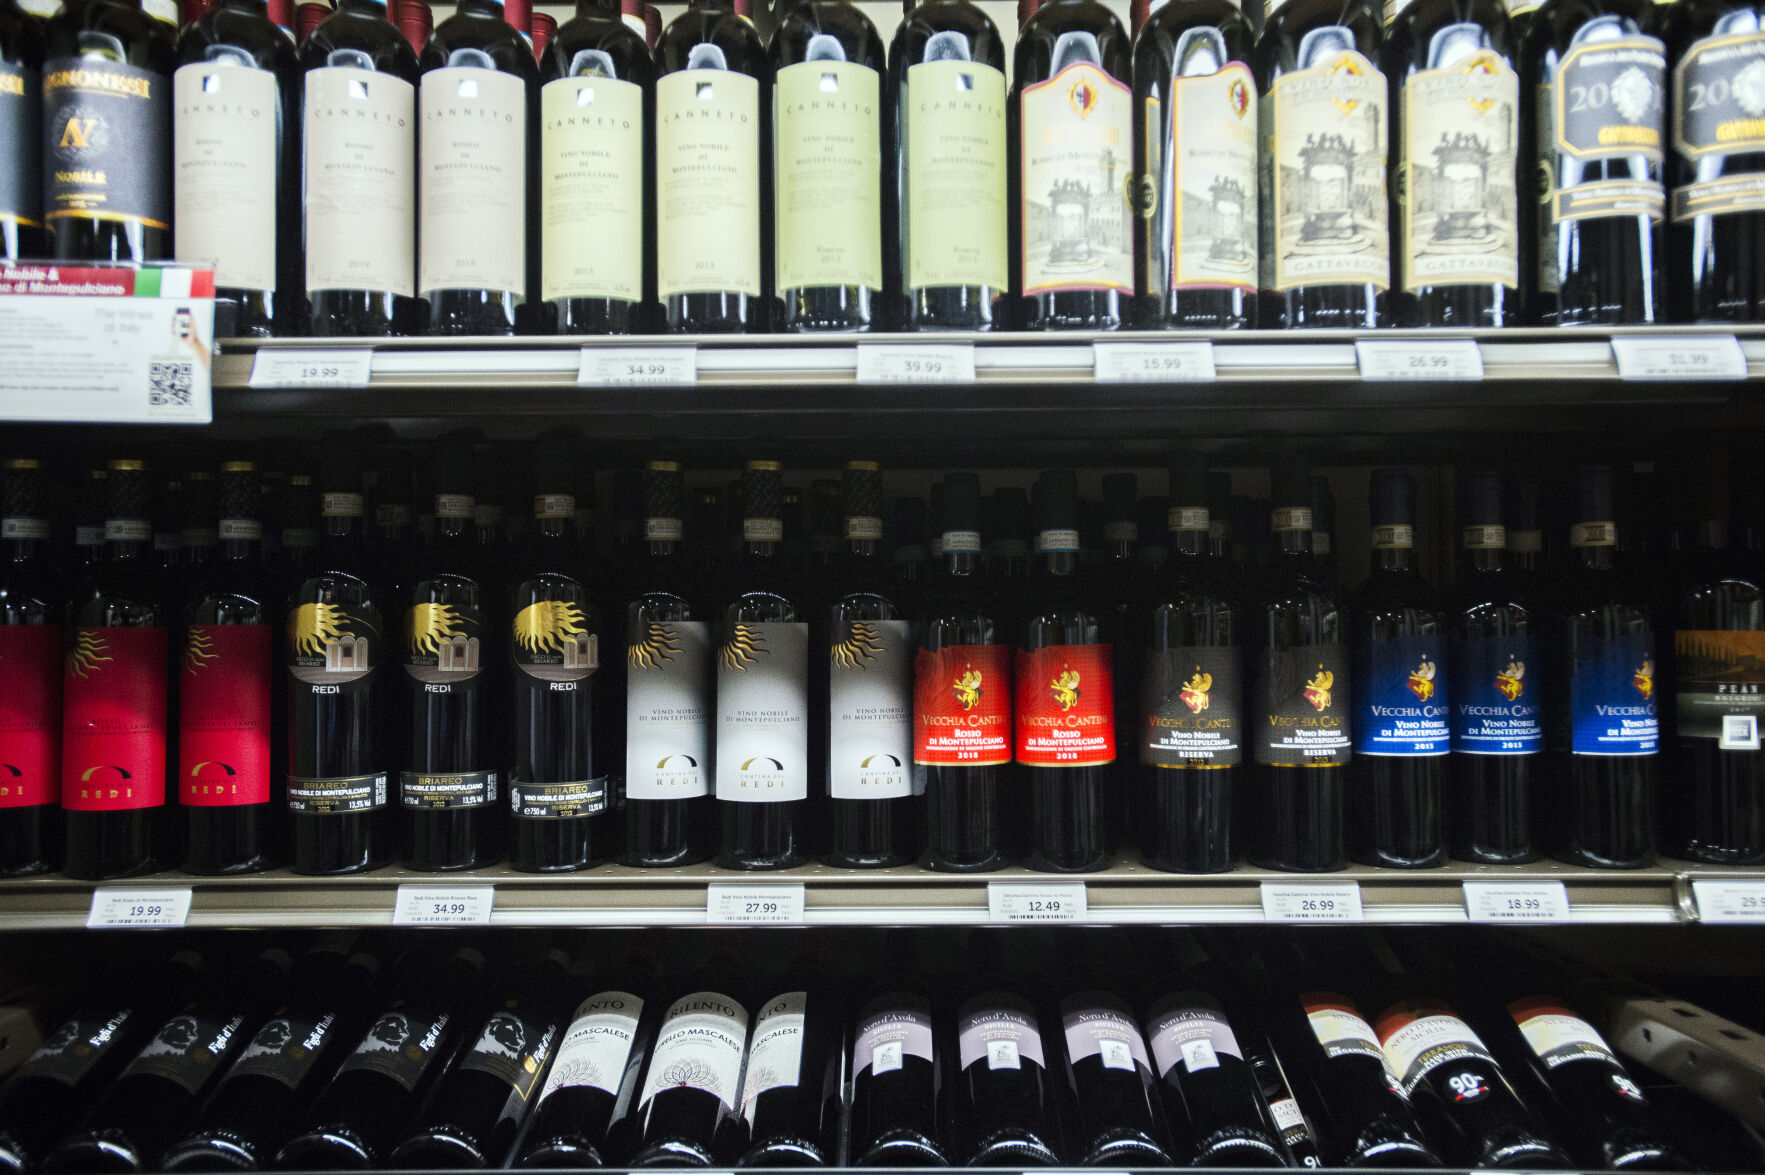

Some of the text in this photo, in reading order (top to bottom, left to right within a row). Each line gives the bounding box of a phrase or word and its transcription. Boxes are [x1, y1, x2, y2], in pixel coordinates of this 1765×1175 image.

[786, 101, 872, 116] CANNETO
[921, 101, 1002, 121] CANNETO
[664, 109, 748, 125] CANNETO
[548, 116, 630, 132] CANNETO
[627, 364, 665, 376] 34.99
[903, 360, 942, 373] 39.99
[312, 685, 340, 694] REDI
[424, 684, 451, 693] REDI
[550, 682, 577, 691] REDI
[1381, 729, 1392, 737] DI
[1468, 727, 1478, 735] DI
[1028, 738, 1036, 746] DI
[1160, 737, 1169, 745] DI
[1303, 749, 1337, 757] RISERVA
[303, 781, 349, 790] BRIAREO
[418, 777, 463, 785] BRIAREO
[656, 776, 698, 786] REDI
[740, 780, 784, 789] REDI
[861, 776, 902, 785] REDI
[544, 785, 588, 795] BRIAREO
[433, 904, 466, 914] 34.99
[745, 902, 777, 914] 27.99
[1028, 901, 1060, 912] 12.49
[1301, 900, 1335, 911] 26.99
[1508, 899, 1540, 910] 18.99
[129, 905, 163, 917] 19.99
[670, 1001, 735, 1018] RILENTO
[864, 1013, 917, 1033] Nero d'Avola
[971, 1012, 1028, 1027] Nero d'Avola
[1079, 1013, 1101, 1023] Nero
[1159, 1012, 1216, 1031] Nero d'Avola
[573, 1028, 630, 1041] MASCALESE
[688, 1029, 741, 1052] MASCALESE
[1449, 1073, 1478, 1094] 90
